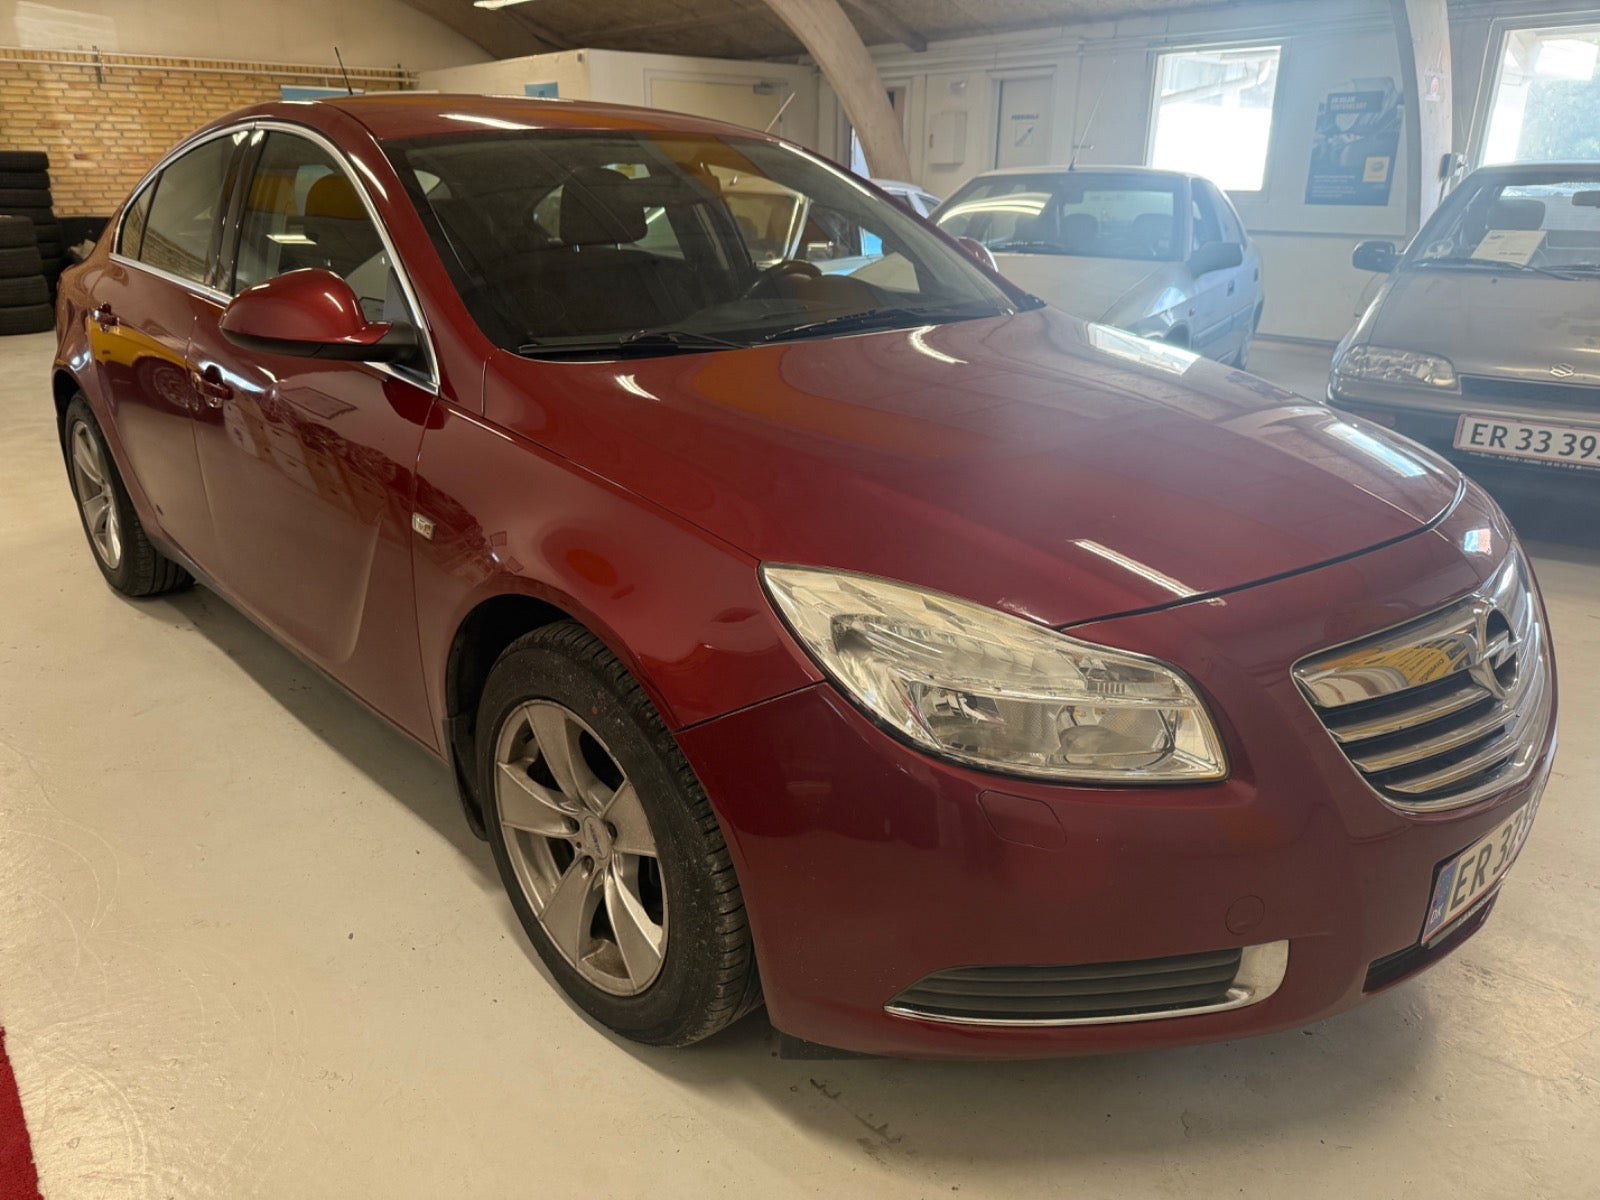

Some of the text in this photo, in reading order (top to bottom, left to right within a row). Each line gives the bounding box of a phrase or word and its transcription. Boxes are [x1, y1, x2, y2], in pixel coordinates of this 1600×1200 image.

[1470, 422, 1600, 460] ER 33 39
[1450, 843, 1493, 912] ER
